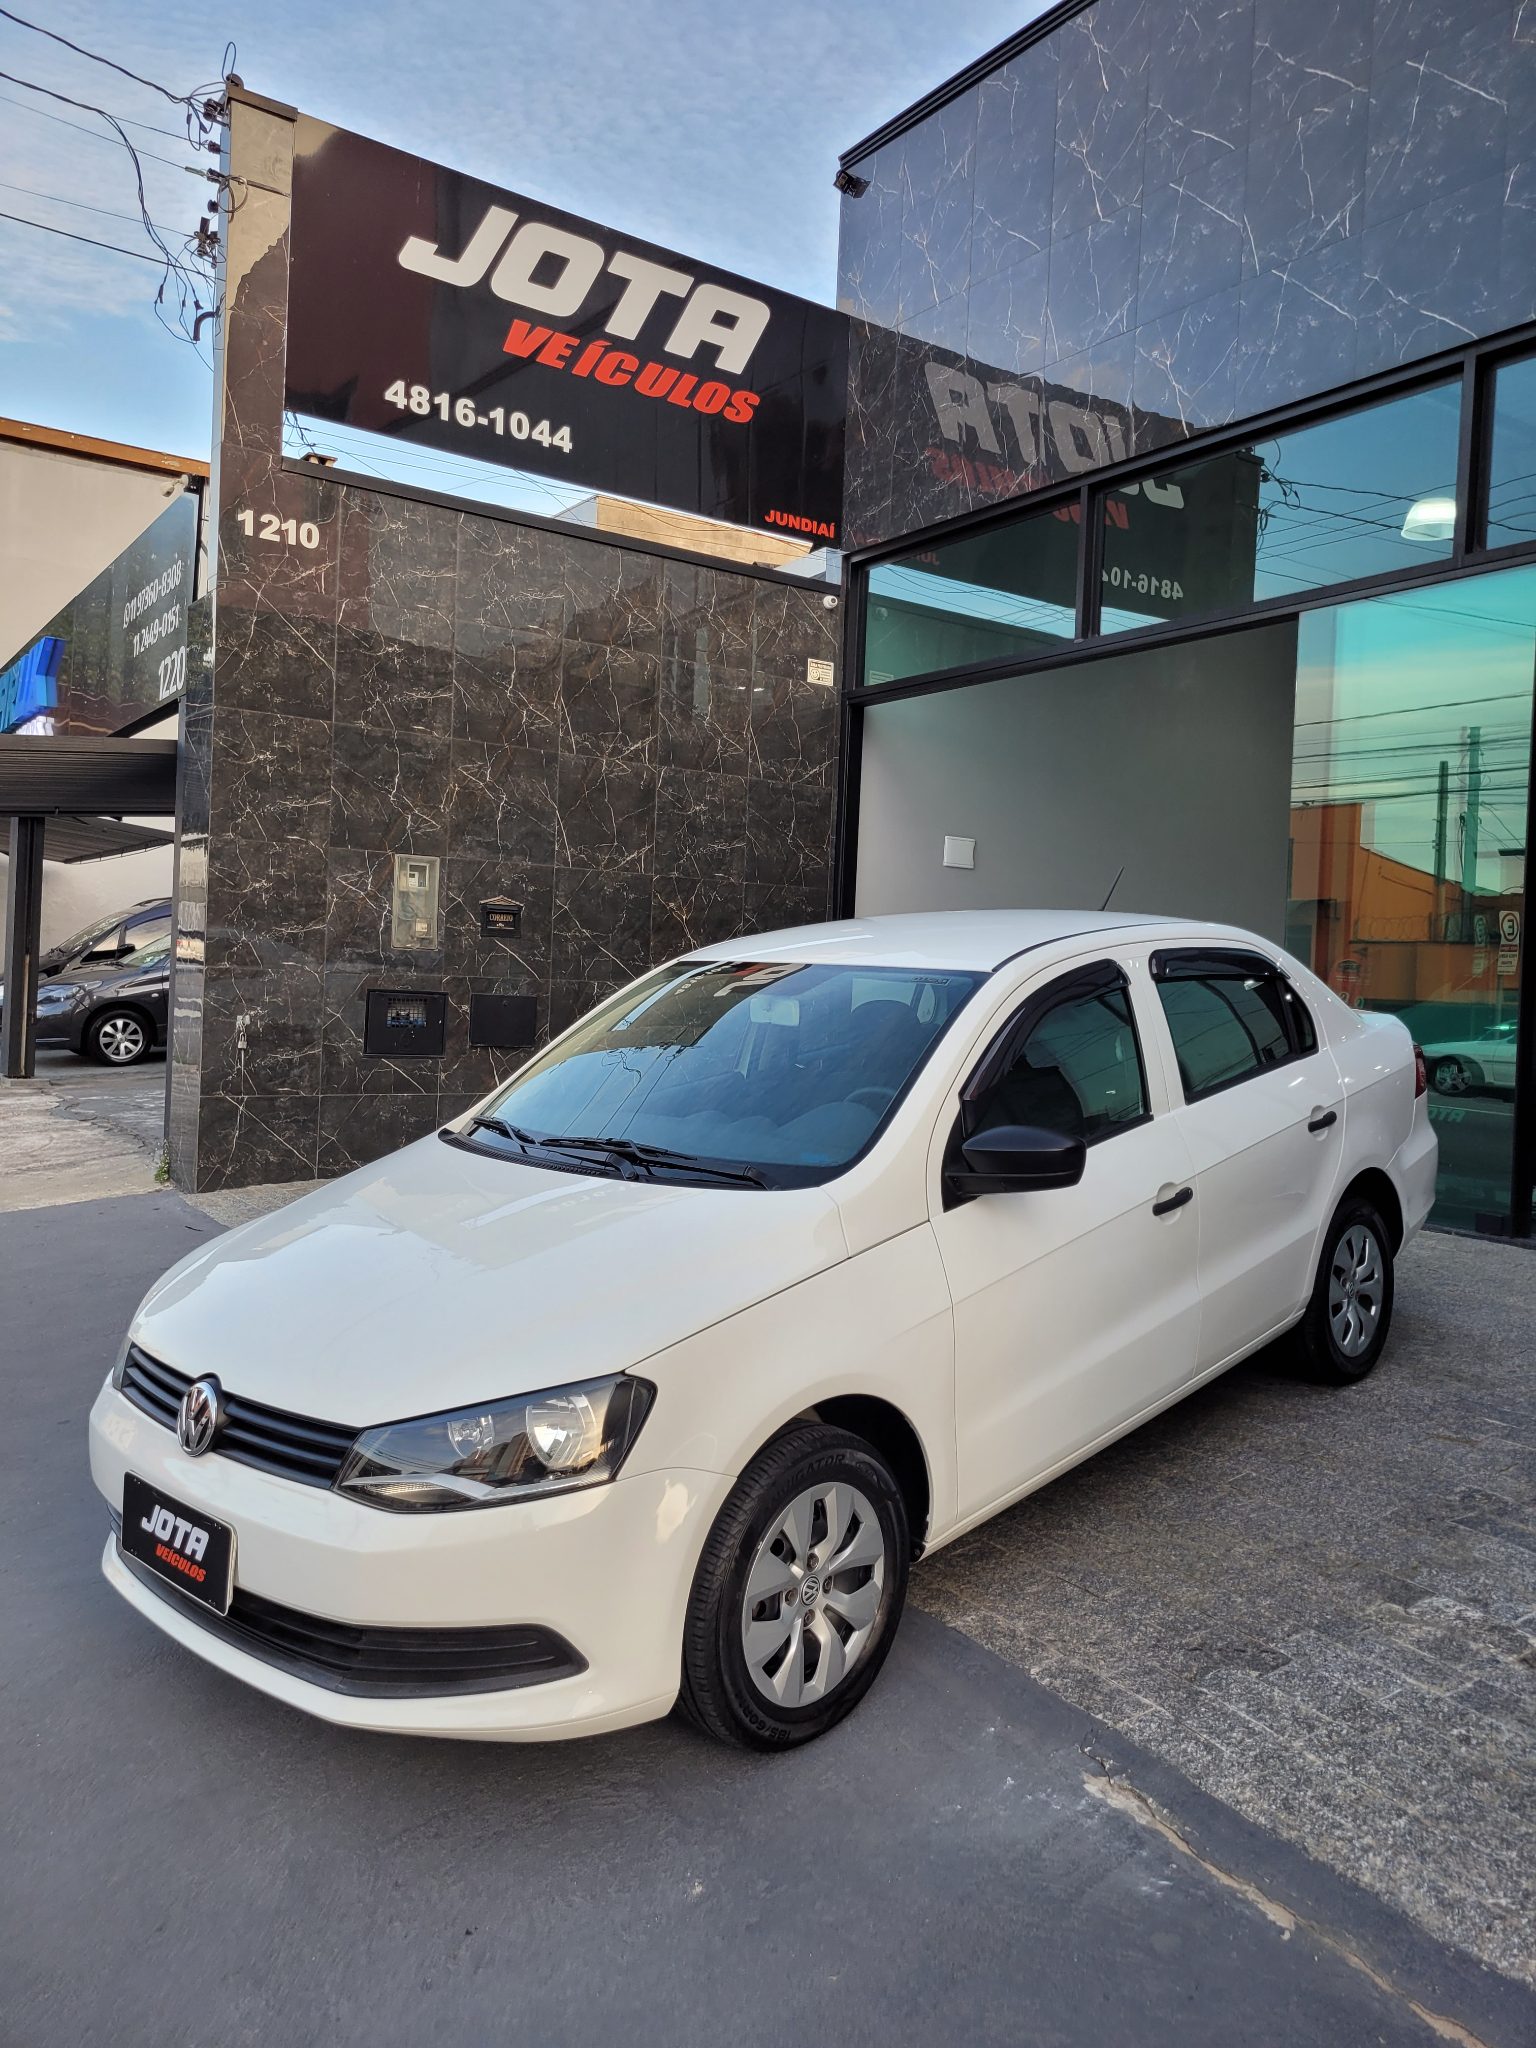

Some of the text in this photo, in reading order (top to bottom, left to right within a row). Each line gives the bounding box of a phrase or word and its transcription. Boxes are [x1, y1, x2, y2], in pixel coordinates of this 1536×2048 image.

[398, 205, 771, 375] JOTA
[502, 318, 761, 424] VEÍCULOS
[384, 380, 573, 454] 4816-1044
[237, 509, 320, 549] 1210
[764, 509, 836, 539] JUNDIAÍ
[158, 645, 186, 701] 1220
[141, 1504, 210, 1562] JOTA
[155, 1543, 207, 1582] VEÍCULOS
